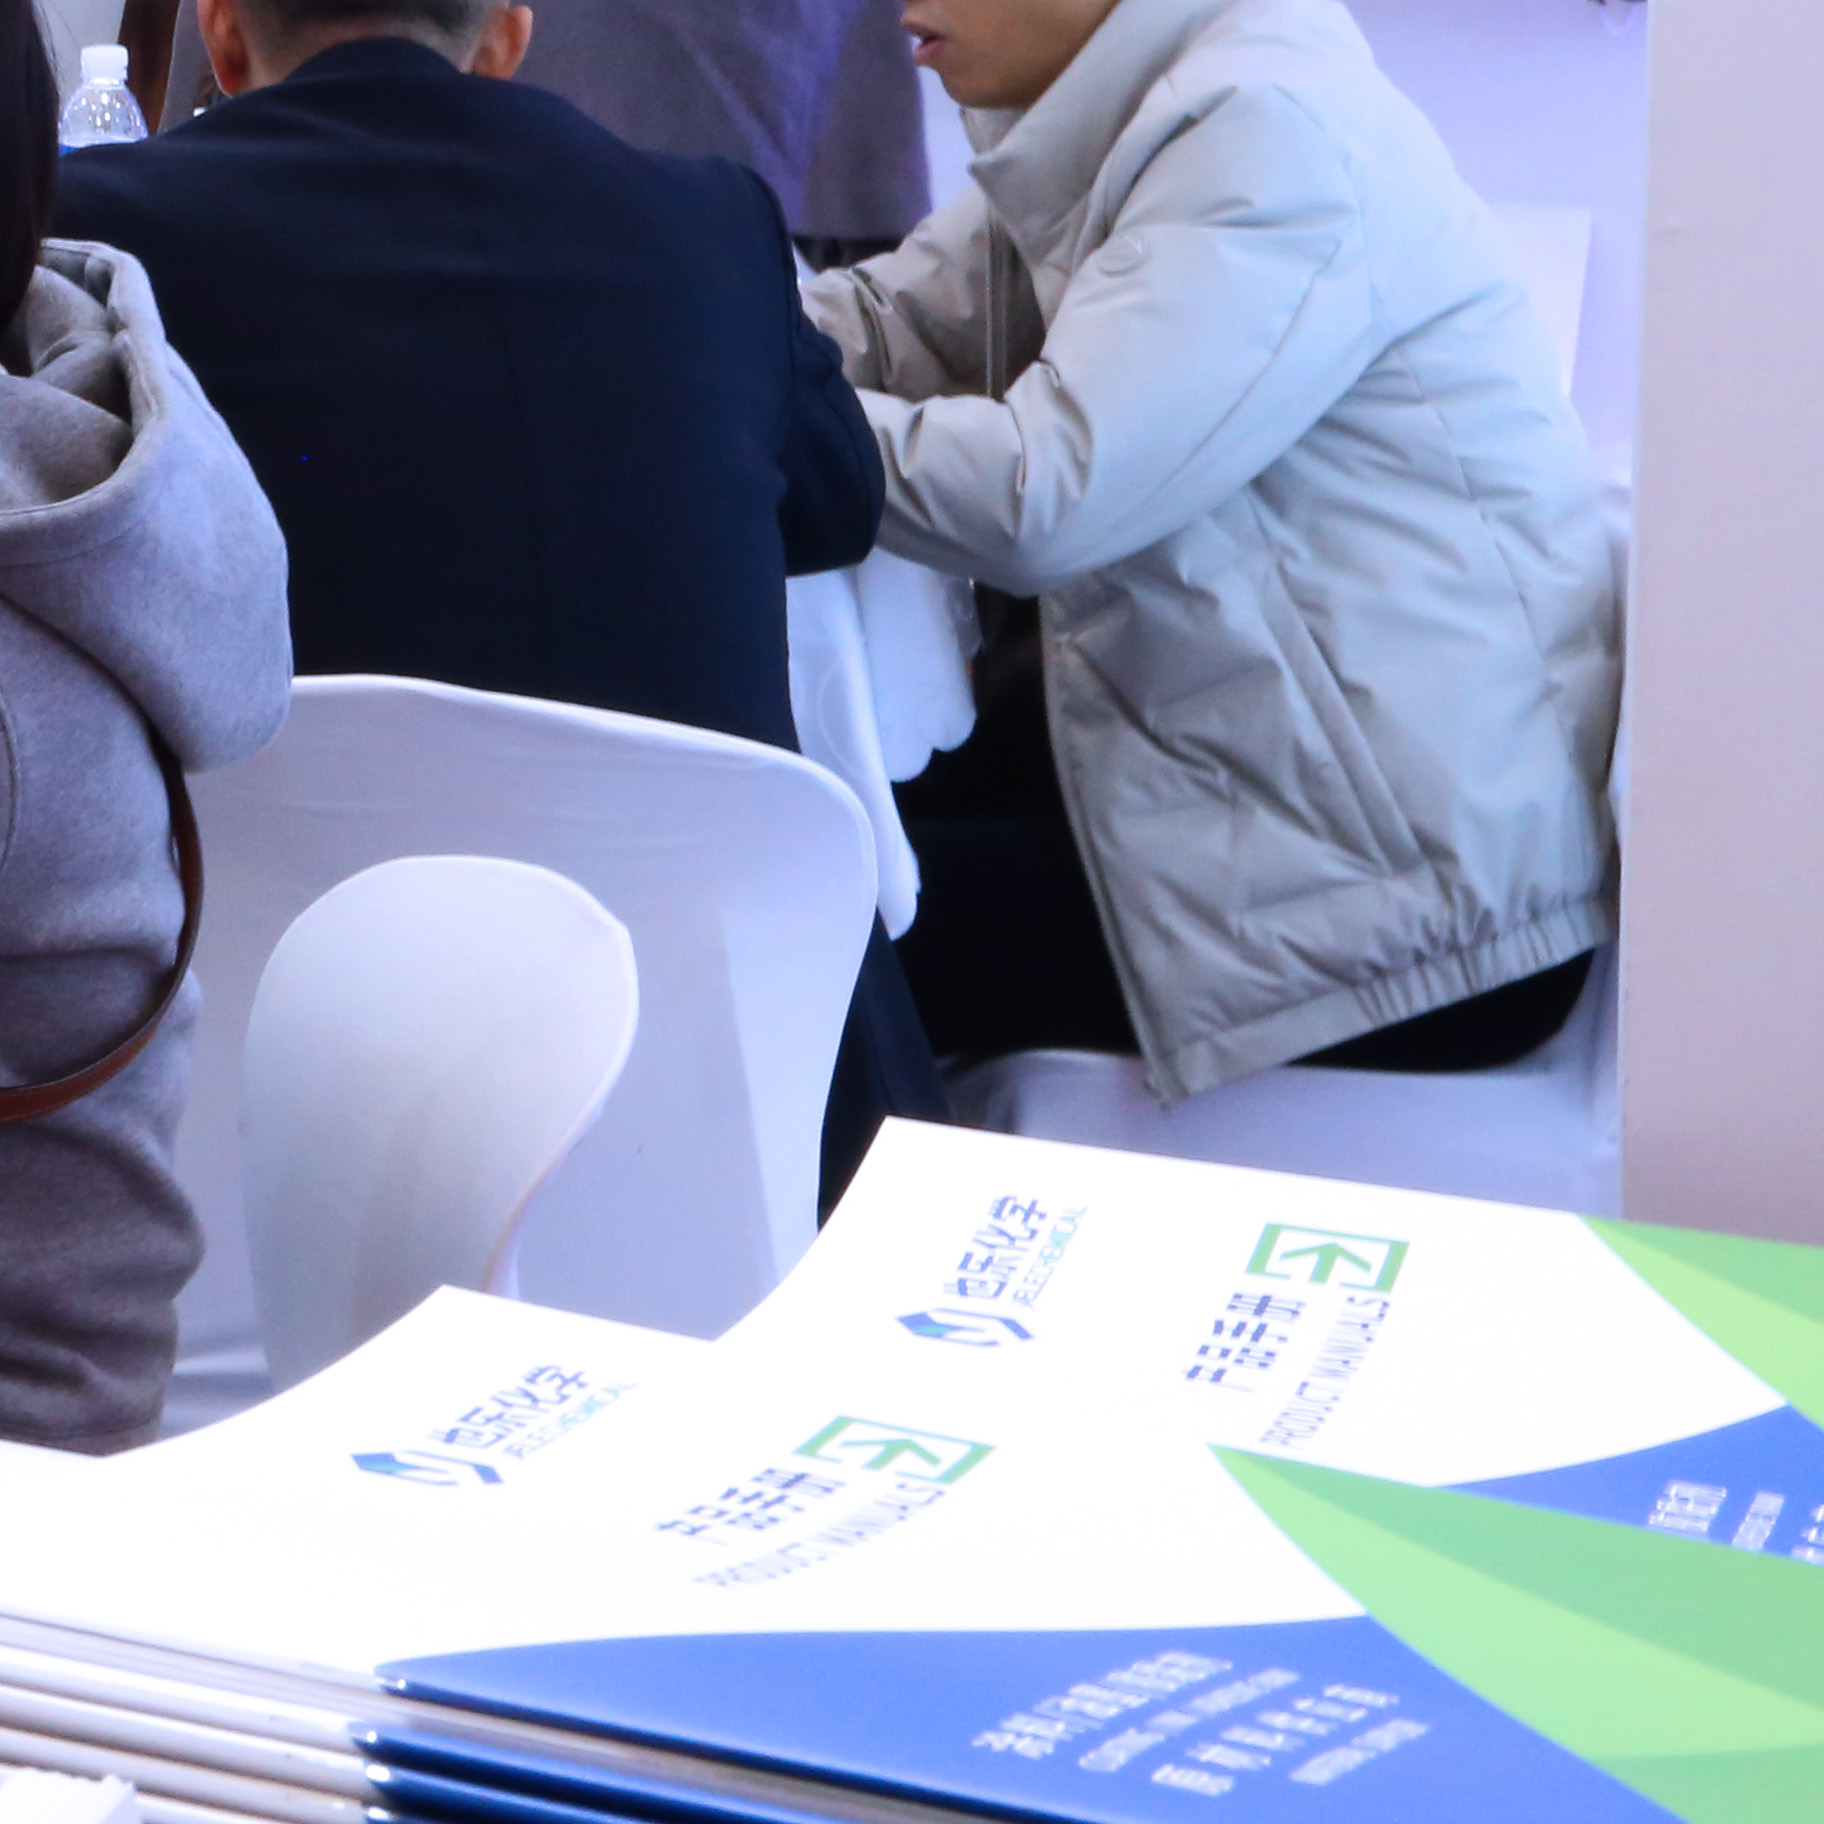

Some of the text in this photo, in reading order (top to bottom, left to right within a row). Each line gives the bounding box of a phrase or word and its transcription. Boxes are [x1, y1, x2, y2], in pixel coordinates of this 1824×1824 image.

[943, 1195, 1048, 1300] 也乐化学
[1182, 1290, 1308, 1393] 产品手册
[655, 1467, 847, 1547] 产品手册
